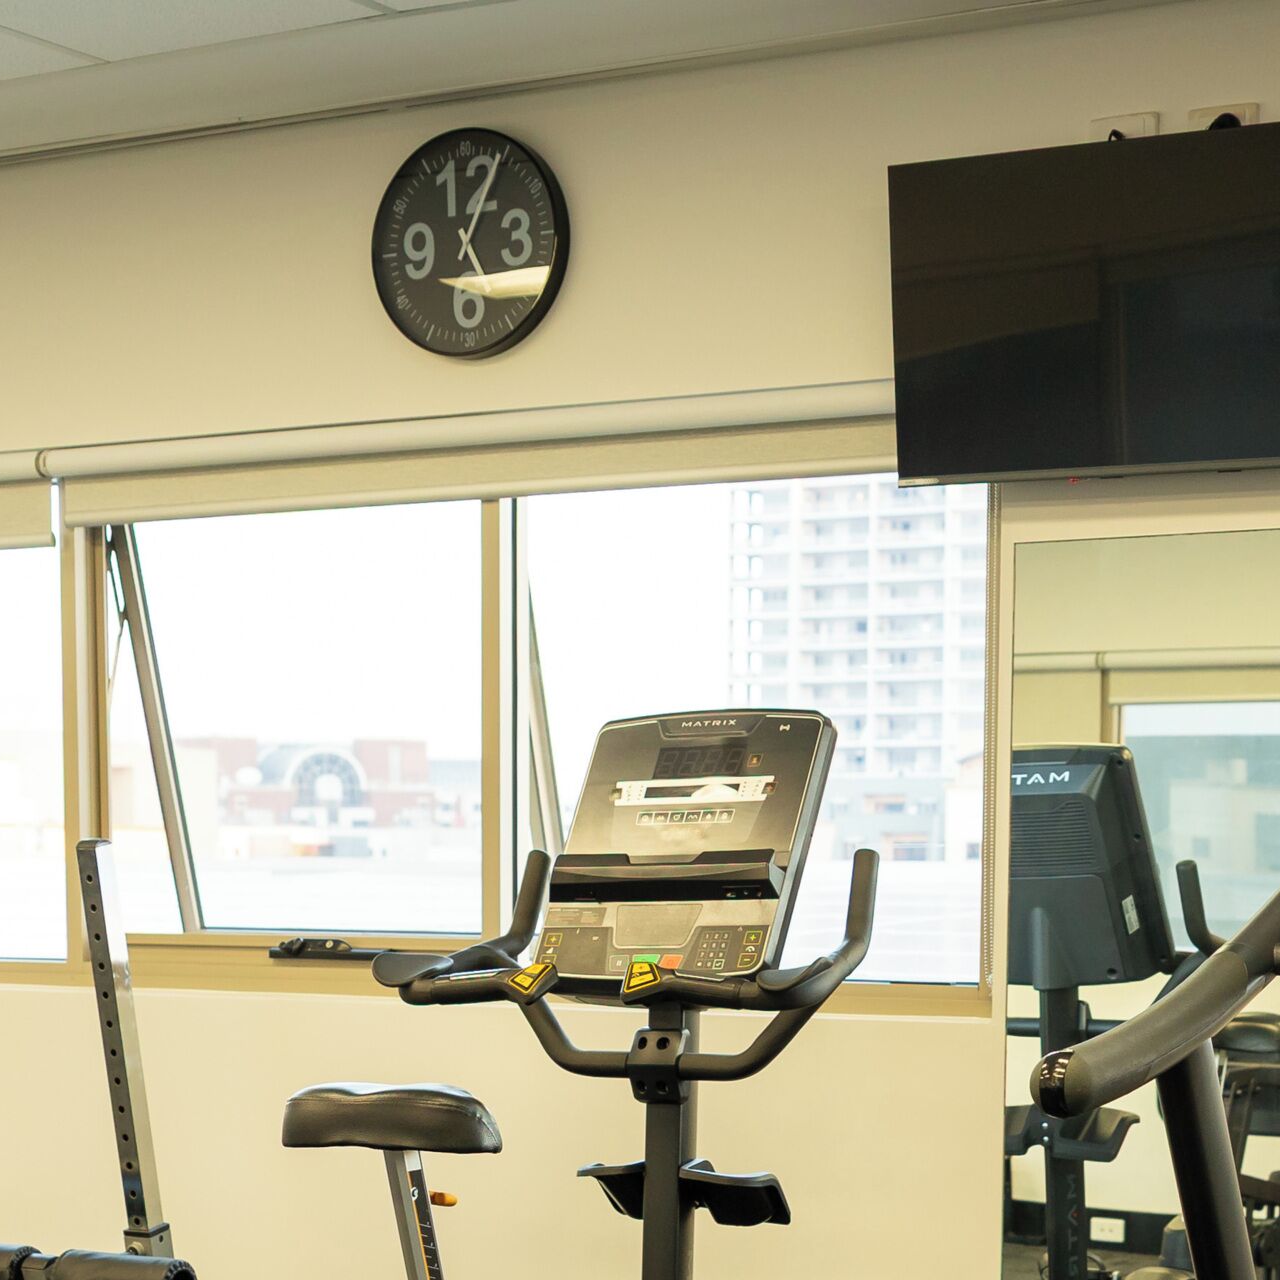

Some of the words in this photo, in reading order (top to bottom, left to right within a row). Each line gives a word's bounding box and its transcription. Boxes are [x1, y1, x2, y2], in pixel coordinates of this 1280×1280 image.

[436, 154, 498, 218] 12
[403, 222, 435, 280] 9
[501, 208, 533, 266] 3
[453, 271, 485, 328] 6
[681, 719, 737, 728] MATRIX
